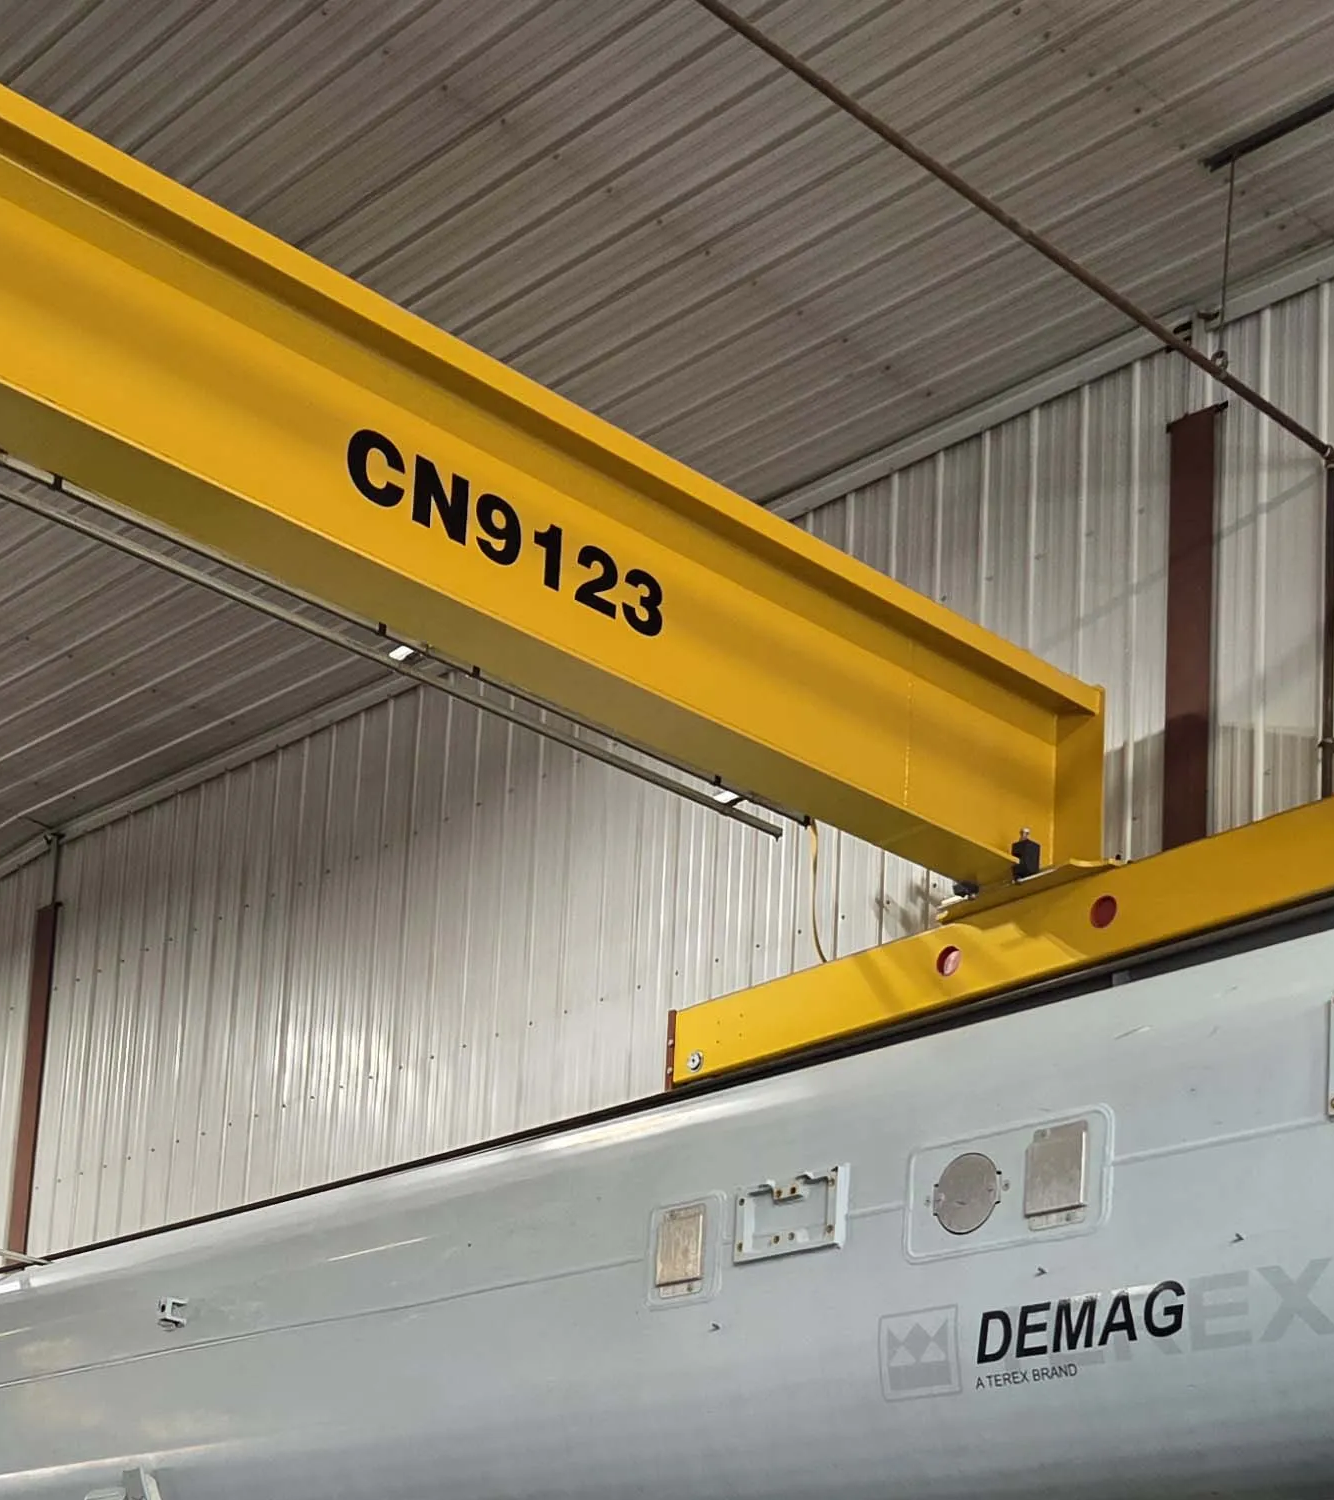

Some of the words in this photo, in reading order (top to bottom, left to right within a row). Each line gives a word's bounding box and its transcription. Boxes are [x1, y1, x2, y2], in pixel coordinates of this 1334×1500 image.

[347, 429, 663, 637] CN9123
[976, 1279, 1185, 1365] DEMAG
[975, 1376, 985, 1390] A
[986, 1370, 1029, 1388] TEREX
[1032, 1363, 1078, 1382] BRAND
